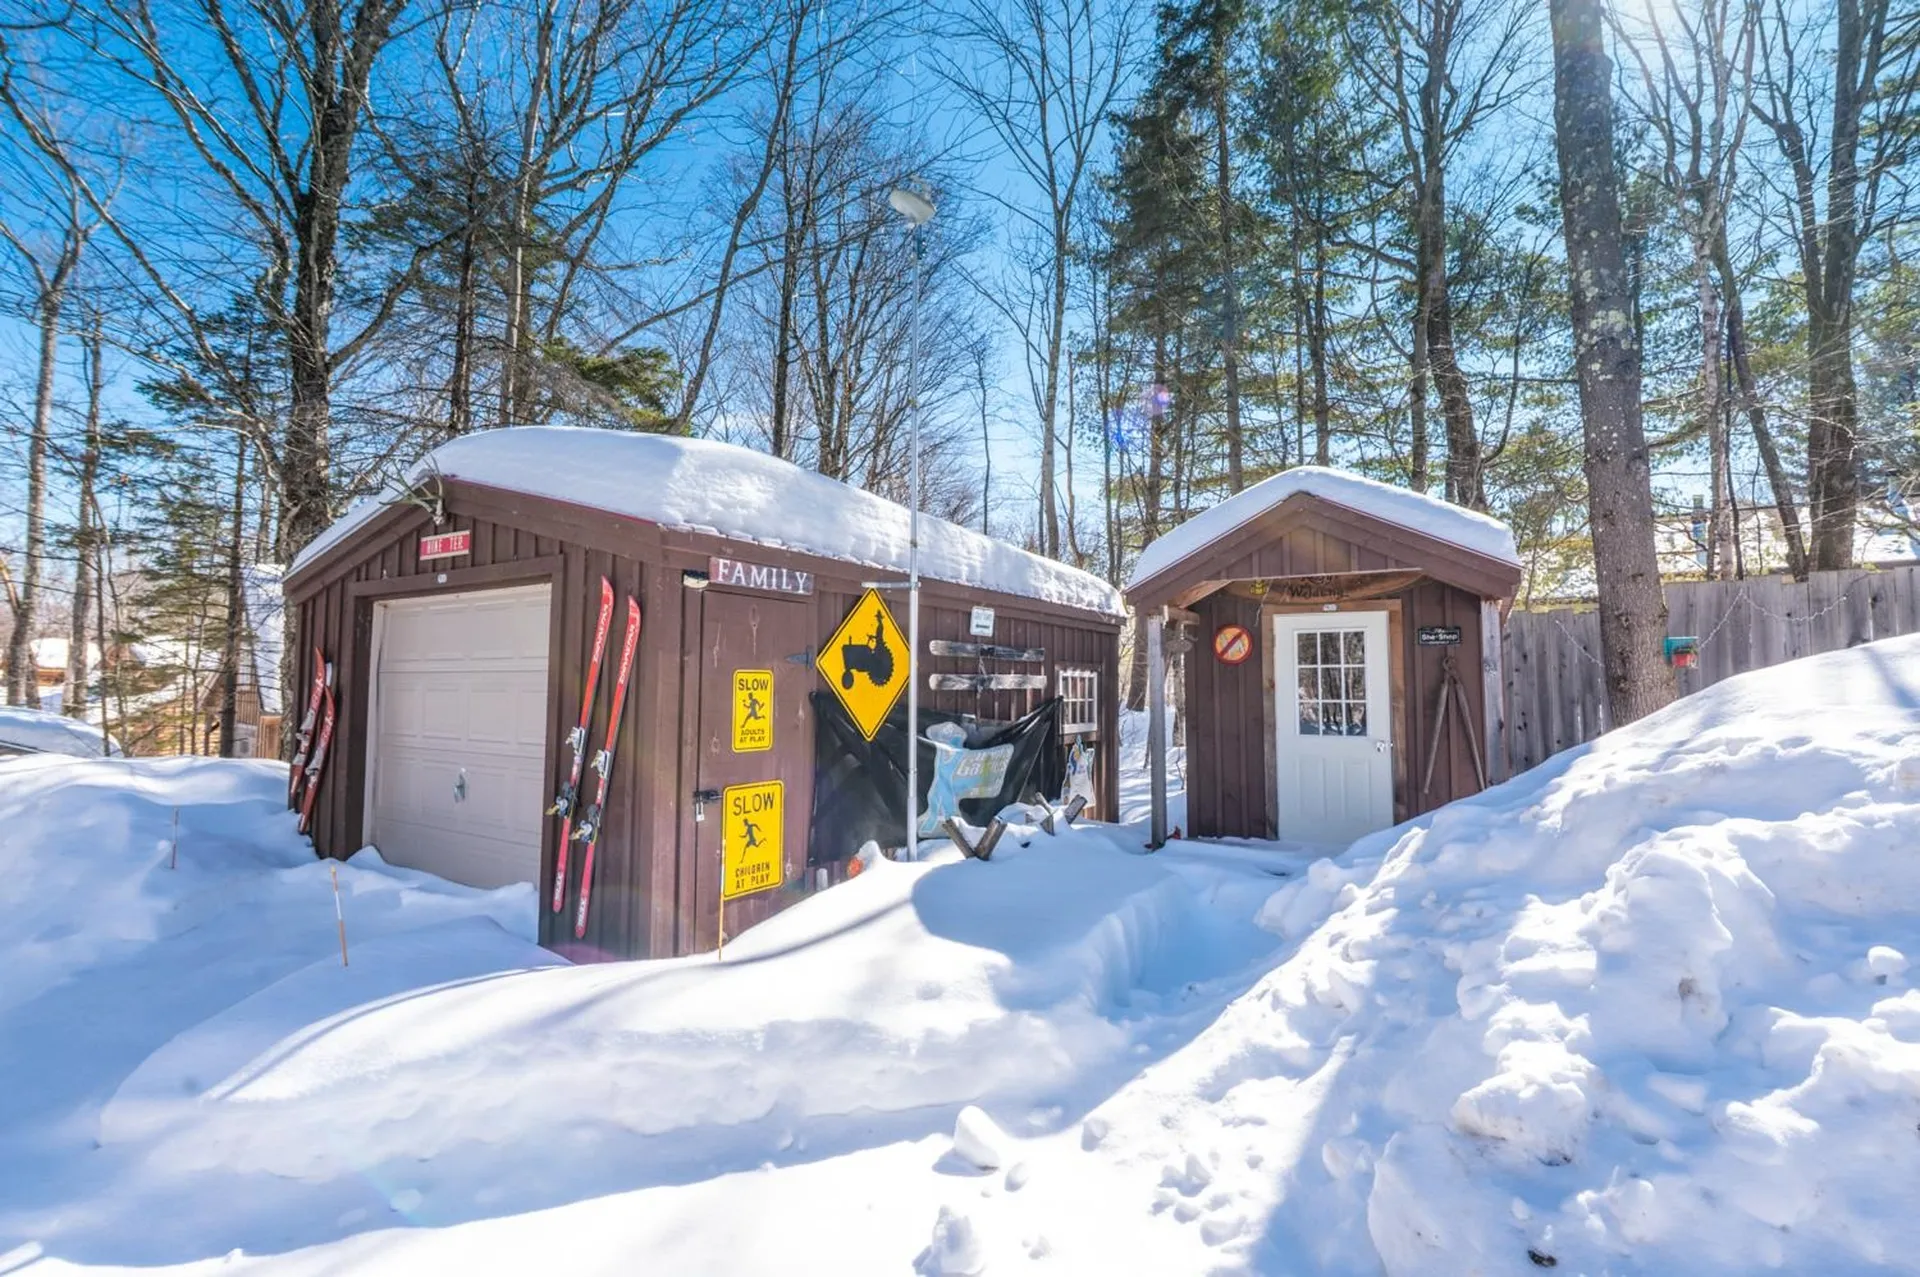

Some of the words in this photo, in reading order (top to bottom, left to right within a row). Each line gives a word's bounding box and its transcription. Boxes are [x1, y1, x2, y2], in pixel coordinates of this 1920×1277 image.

[717, 558, 808, 594] FAMILY
[738, 678, 769, 691] SLOW
[741, 728, 765, 736] ADULTS
[750, 735, 766, 743] PLAY
[733, 791, 775, 816] SLOW
[735, 861, 771, 878] CHILDREN
[736, 879, 745, 890] AT
[750, 873, 770, 886] PLAY
